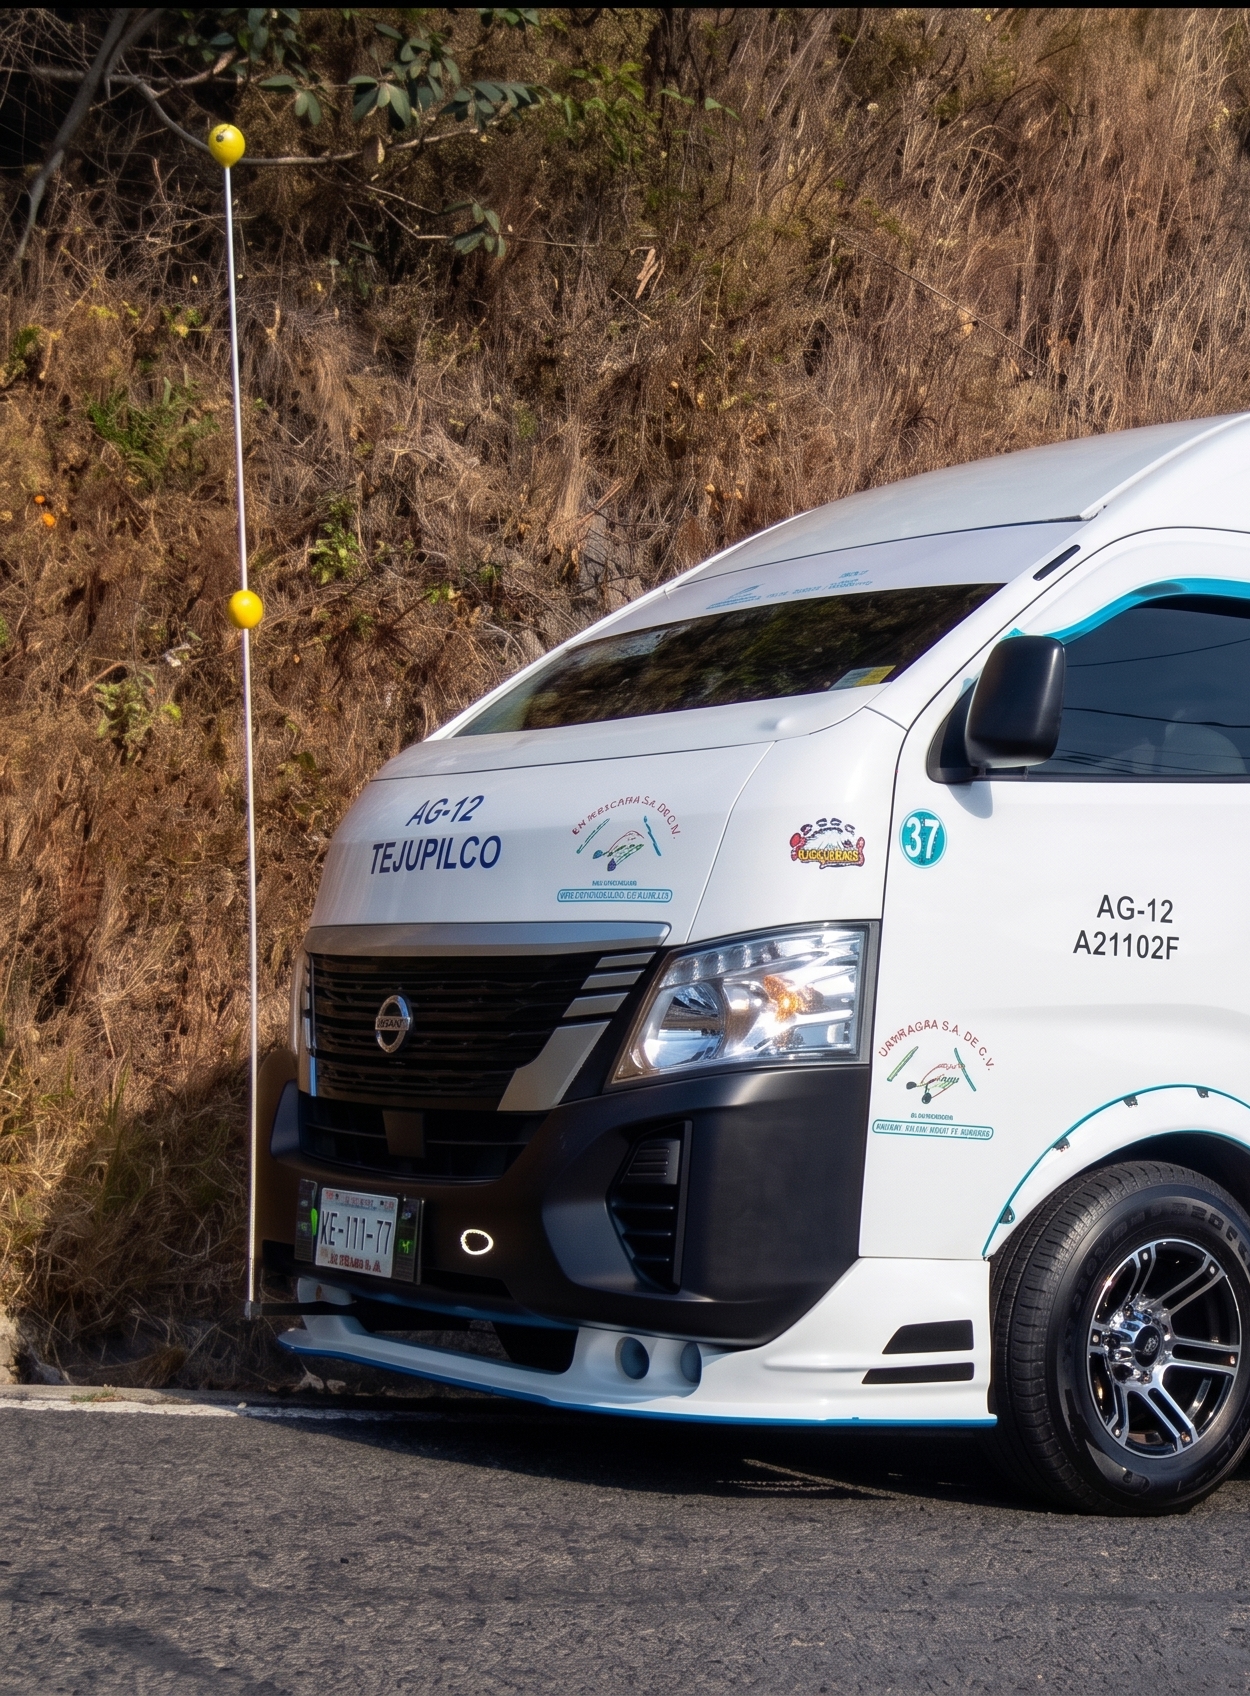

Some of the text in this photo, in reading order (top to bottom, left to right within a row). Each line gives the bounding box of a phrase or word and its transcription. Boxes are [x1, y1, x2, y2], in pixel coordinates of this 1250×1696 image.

[405, 794, 485, 827] AG-12
[905, 816, 940, 859] 37
[370, 835, 502, 875] TEJUPILCO
[1096, 894, 1174, 924] AG-12
[1072, 929, 1180, 960] A21102F
[963, 1031, 980, 1049] DE
